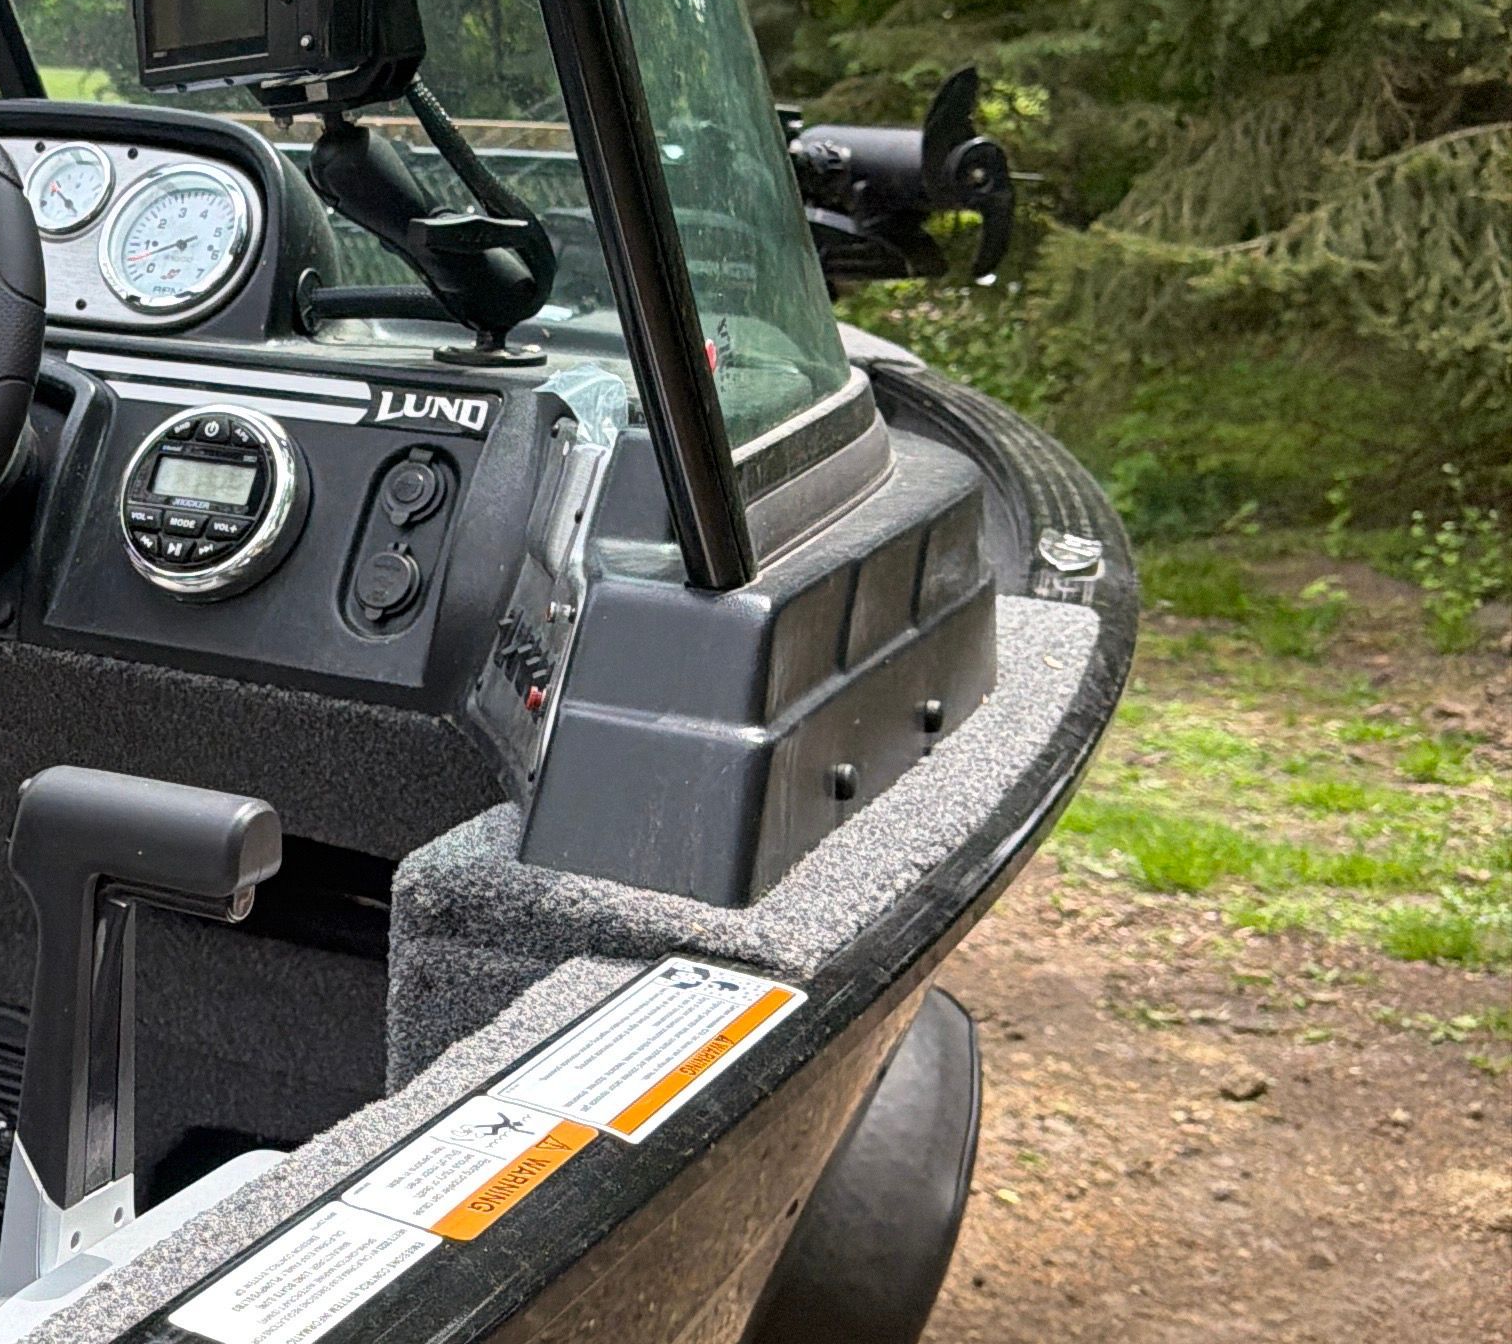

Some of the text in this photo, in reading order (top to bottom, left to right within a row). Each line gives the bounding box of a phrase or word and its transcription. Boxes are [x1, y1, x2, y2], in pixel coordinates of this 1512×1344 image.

[178, 207, 187, 218] 3
[200, 209, 208, 219] 4
[157, 219, 167, 229] 2
[213, 227, 222, 238] 5
[144, 240, 150, 250] 1
[211, 250, 219, 260] 6
[146, 262, 156, 273] 0
[196, 268, 205, 279] 7
[374, 390, 488, 431] LUND
[169, 517, 196, 529] MODE
[676, 1041, 729, 1076] WARNING
[466, 1155, 551, 1214] WARNING
[326, 1290, 361, 1314] SYSTEM
